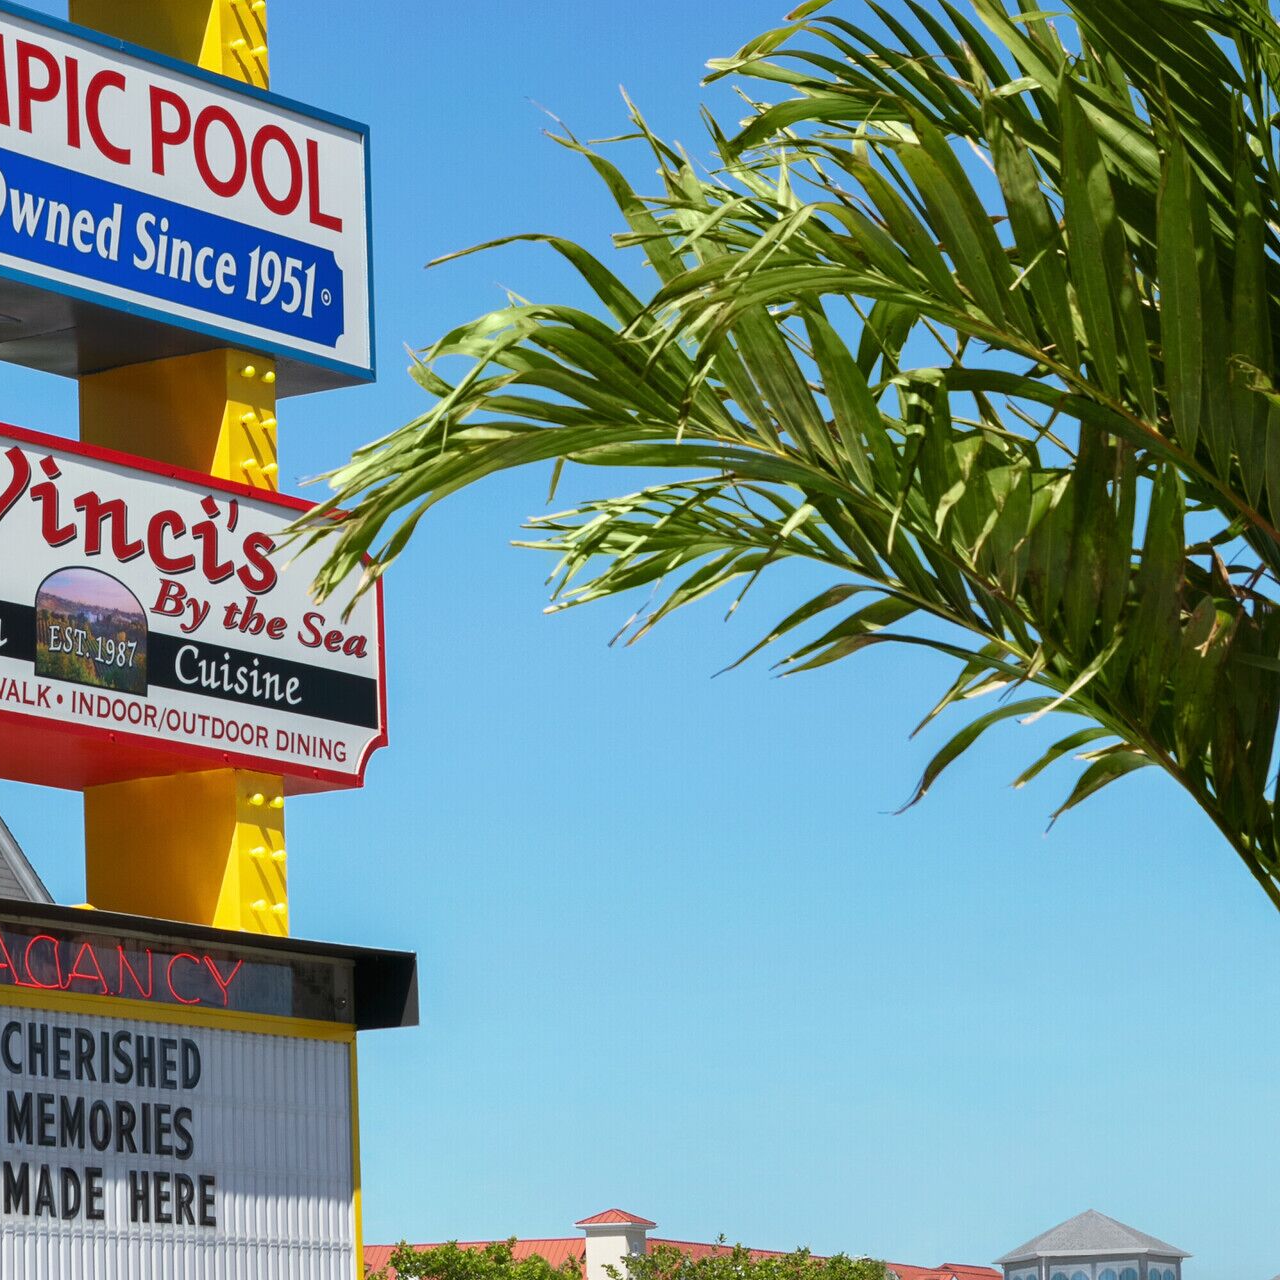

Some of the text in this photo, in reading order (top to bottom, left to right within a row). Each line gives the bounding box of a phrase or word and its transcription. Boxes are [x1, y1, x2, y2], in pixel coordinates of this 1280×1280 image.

[149, 84, 342, 232] POOL
[133, 212, 236, 295] Since
[247, 244, 317, 318] 1951
[48, 625, 137, 669] EST. 1987
[150, 577, 368, 659] By the Sea
[174, 644, 302, 705] Cuisine
[71, 692, 269, 749] INDOOR/OUTDOOR
[276, 729, 347, 763] DINING
[1, 1021, 201, 1090] CHERISHED
[7, 1090, 194, 1161] MEMORIES
[3, 1161, 217, 1228] MADE HERE
